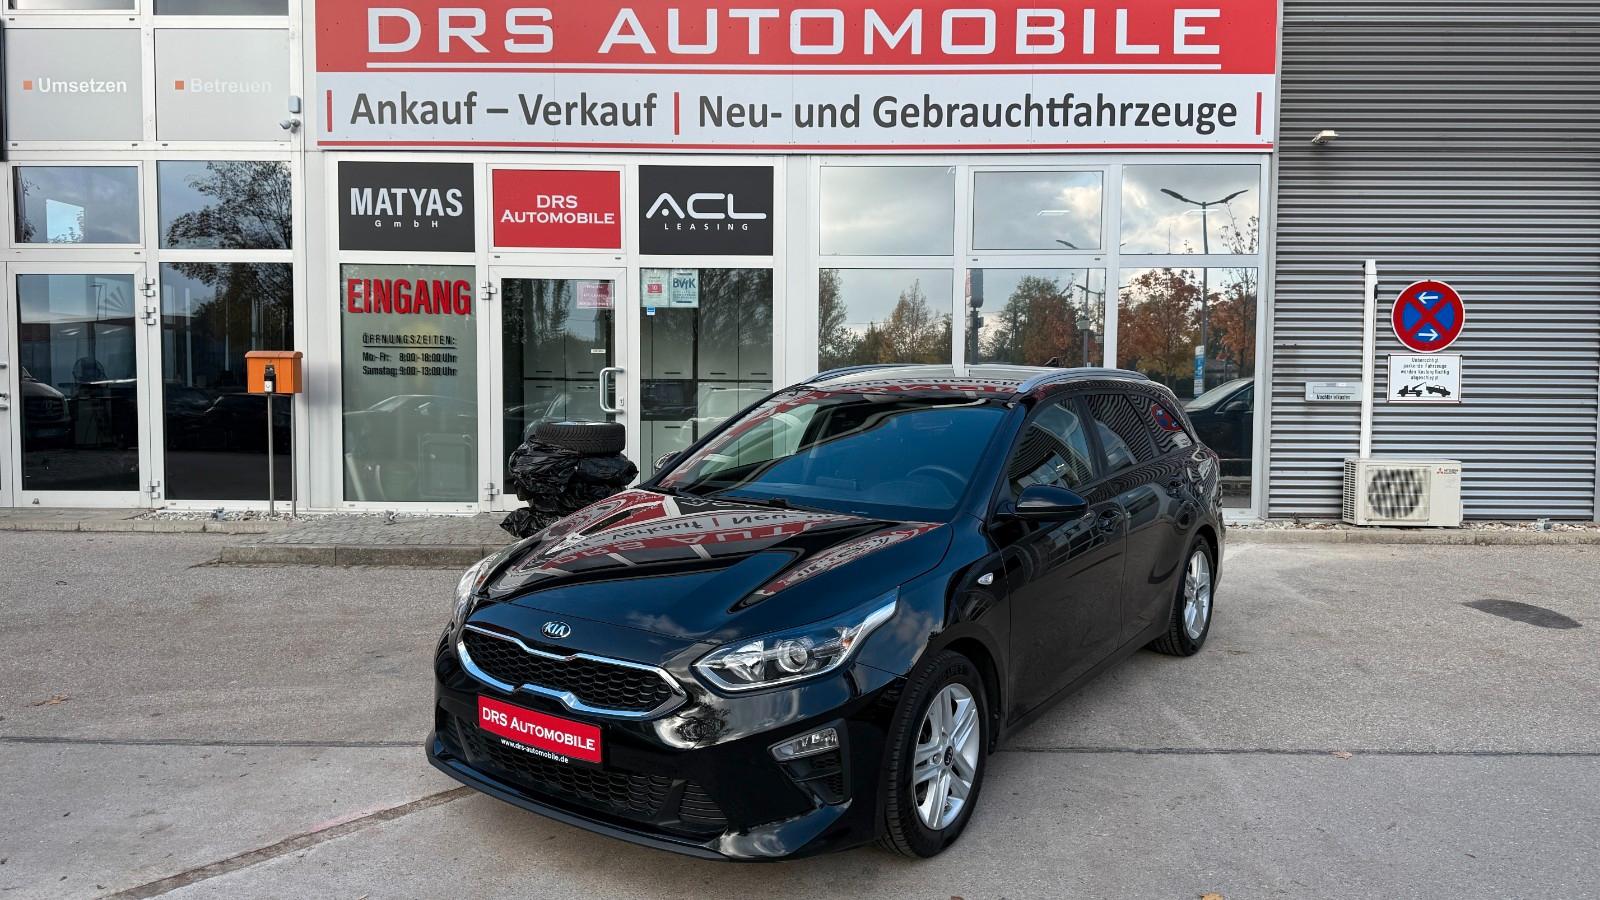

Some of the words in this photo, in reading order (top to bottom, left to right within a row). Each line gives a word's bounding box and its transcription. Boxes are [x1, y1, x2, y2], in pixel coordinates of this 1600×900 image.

[367, 7, 554, 54] DRS
[598, 8, 1221, 55] AUTOMOBILE
[38, 78, 127, 93] Umsetzen
[191, 78, 272, 93] Betreuen
[350, 91, 477, 126] Ankauf
[518, 92, 657, 127] Verkauf
[699, 95, 783, 128] Neu-
[794, 94, 861, 129] und
[873, 93, 1237, 135] Gebrauchtfahrzeuge
[350, 187, 463, 217] MATYAS
[536, 195, 578, 209] DRS
[645, 192, 767, 219] ACL
[374, 219, 439, 228] GmbH
[500, 209, 615, 225] AUTOMOBILE
[664, 223, 748, 231] LEASING
[347, 278, 472, 315] EINGANG
[362, 332, 456, 345] ÖFFNUNGSZEITEN:
[442, 352, 458, 363] Uhr
[442, 366, 458, 376] Uhr
[545, 622, 566, 636] KIA
[482, 706, 508, 727] DRS
[510, 717, 596, 751] AUTOMOBILE
[500, 738, 569, 764] www.drs-automobile.de
